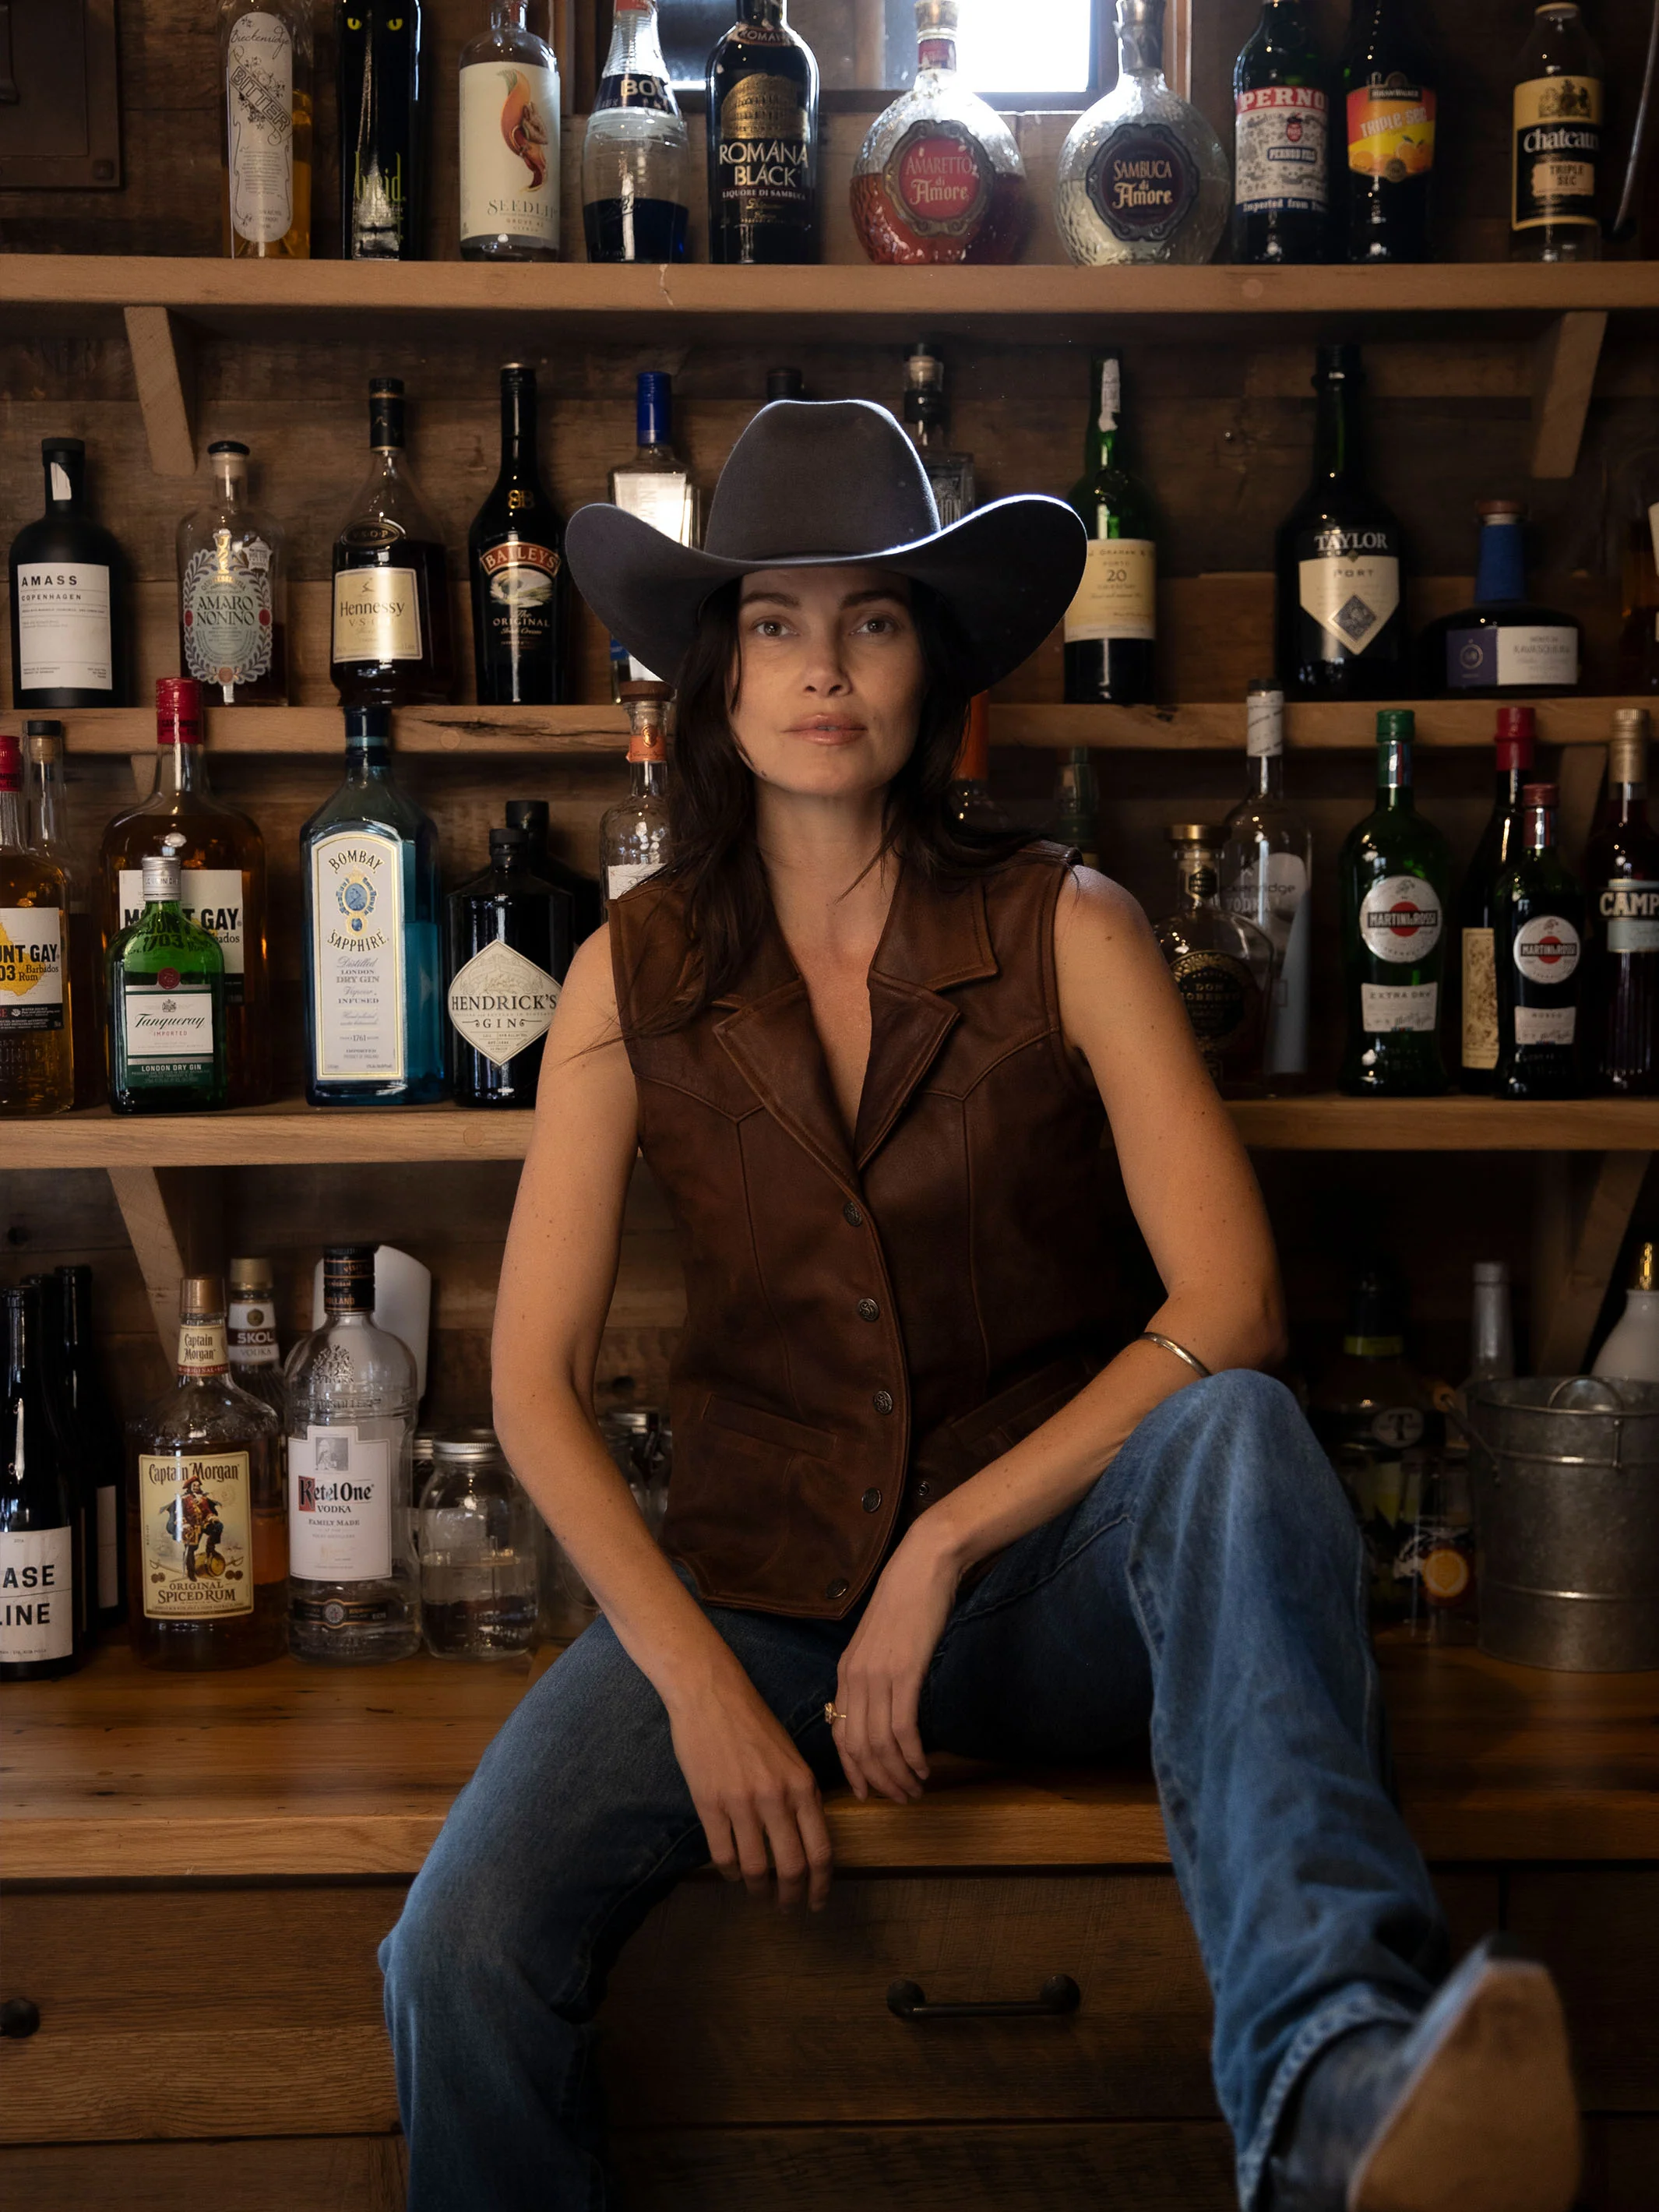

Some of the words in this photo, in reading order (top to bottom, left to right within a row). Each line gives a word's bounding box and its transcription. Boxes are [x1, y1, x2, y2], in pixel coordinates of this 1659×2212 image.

[231, 65, 292, 132] BITTER
[1240, 86, 1329, 112] PERNO
[719, 139, 808, 169] ROMANA
[905, 156, 973, 175] AMARETTO
[1113, 160, 1173, 181] SAMBUCA
[734, 163, 797, 188] BLACK
[935, 176, 946, 186] di
[909, 178, 969, 206] Amore
[1139, 179, 1150, 191] di
[722, 188, 756, 199] LIQUORE
[759, 188, 769, 197] DI
[1111, 181, 1174, 210] Amore
[1243, 199, 1284, 213] Imported
[1287, 198, 1309, 210] from
[1313, 531, 1389, 551] TAYLOR
[484, 545, 556, 569] BAILEYS
[21, 575, 78, 586] AMASS
[1107, 569, 1127, 582] 20
[1333, 569, 1374, 578] PORT
[21, 594, 82, 602] COPENHAGEN
[196, 595, 254, 611] AMARO
[340, 600, 405, 618] Hennessy
[196, 610, 255, 626] NONINO
[492, 617, 551, 628] ORIGINAL
[328, 849, 384, 874] BOMBAY
[200, 907, 239, 931] GAY
[1369, 912, 1410, 927] MARTINI
[327, 928, 386, 953] SAPPHIRE
[30, 943, 58, 963] GAY
[26, 964, 59, 974] Barbados
[336, 956, 379, 968] Distilled
[19, 972, 39, 981] Rum
[451, 994, 558, 1011] HENDRICK'S
[135, 1013, 206, 1030] Tanqueray
[482, 1017, 516, 1029] GIN
[184, 1333, 213, 1349] Captain
[236, 1331, 274, 1344] SKOL
[183, 1347, 215, 1362] Morgan
[188, 1461, 239, 1483] Morgan
[300, 1479, 339, 1509] Ketel
[340, 1481, 373, 1502] One
[317, 1505, 352, 1513] VODKA
[308, 1518, 336, 1527] FAMILY
[2, 1564, 55, 1588] ASE
[168, 1581, 224, 1590] ORIGINAL
[157, 1590, 204, 1604] SPICED
[205, 1588, 236, 1603] RUM
[0, 1602, 51, 1626] INE
